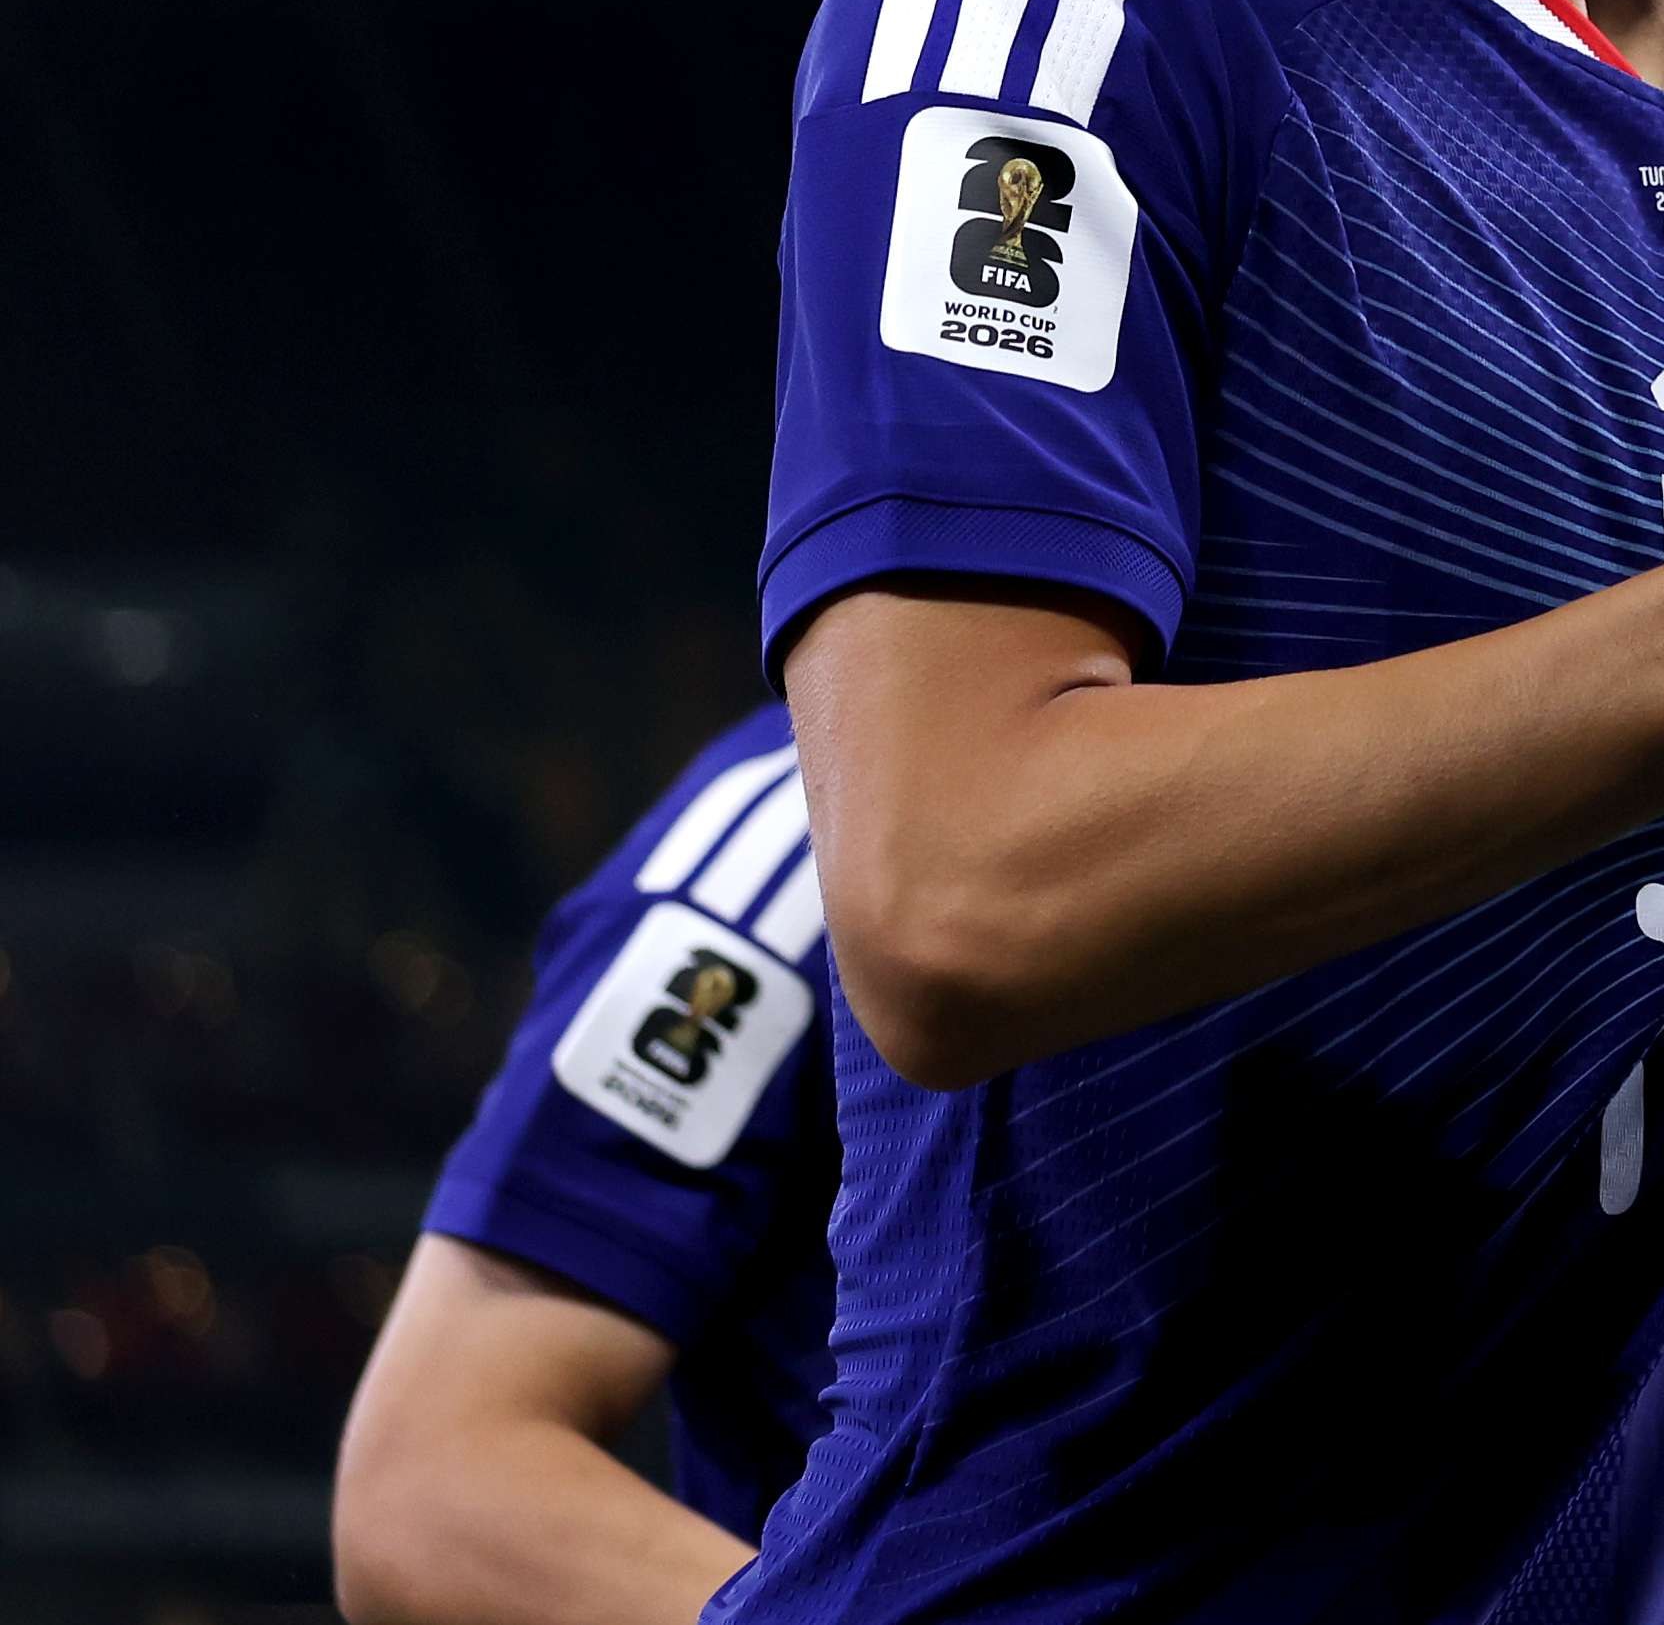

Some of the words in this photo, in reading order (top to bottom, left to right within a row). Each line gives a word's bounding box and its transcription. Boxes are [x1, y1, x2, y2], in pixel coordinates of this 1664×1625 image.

[981, 265, 1032, 293] FIFA
[944, 301, 1016, 324] WORLD
[1019, 314, 1057, 333] CUP
[939, 320, 1054, 360] 2026
